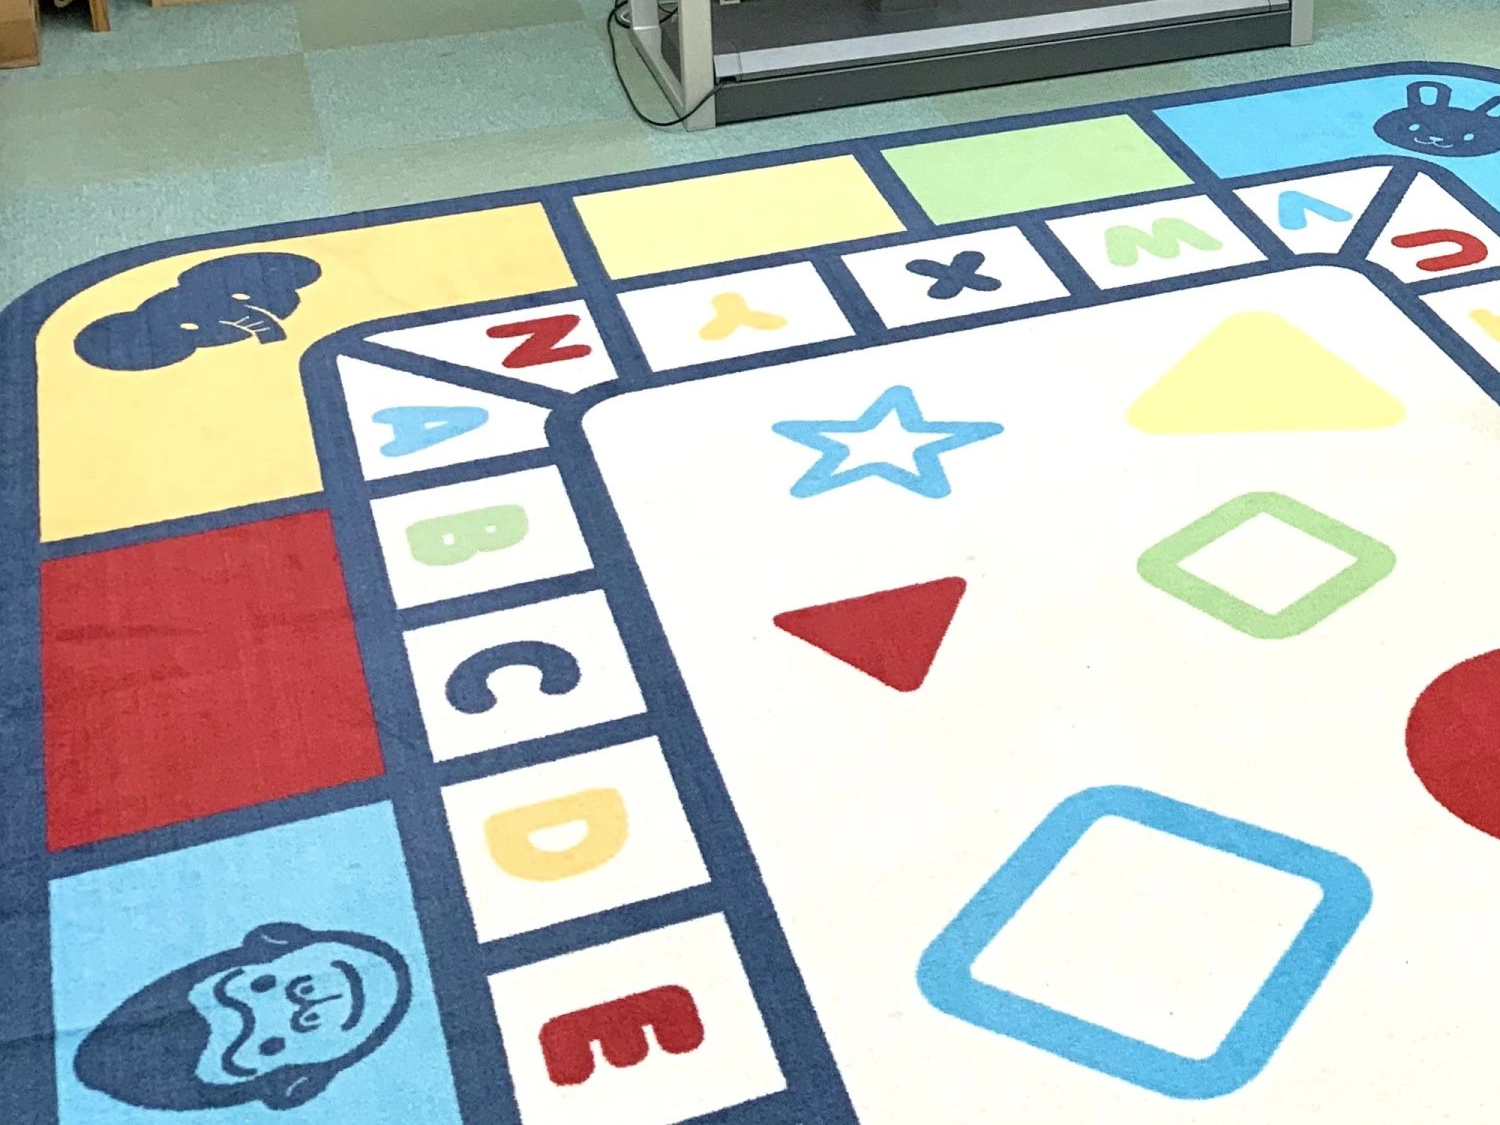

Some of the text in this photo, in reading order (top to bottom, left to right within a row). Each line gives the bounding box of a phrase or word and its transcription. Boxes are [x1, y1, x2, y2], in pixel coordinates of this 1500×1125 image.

[698, 292, 788, 341] Y
[905, 250, 1002, 300] X
[1104, 217, 1224, 268] W
[1277, 190, 1353, 232] V
[1391, 228, 1489, 272] U
[371, 406, 706, 1088] A B C D E
